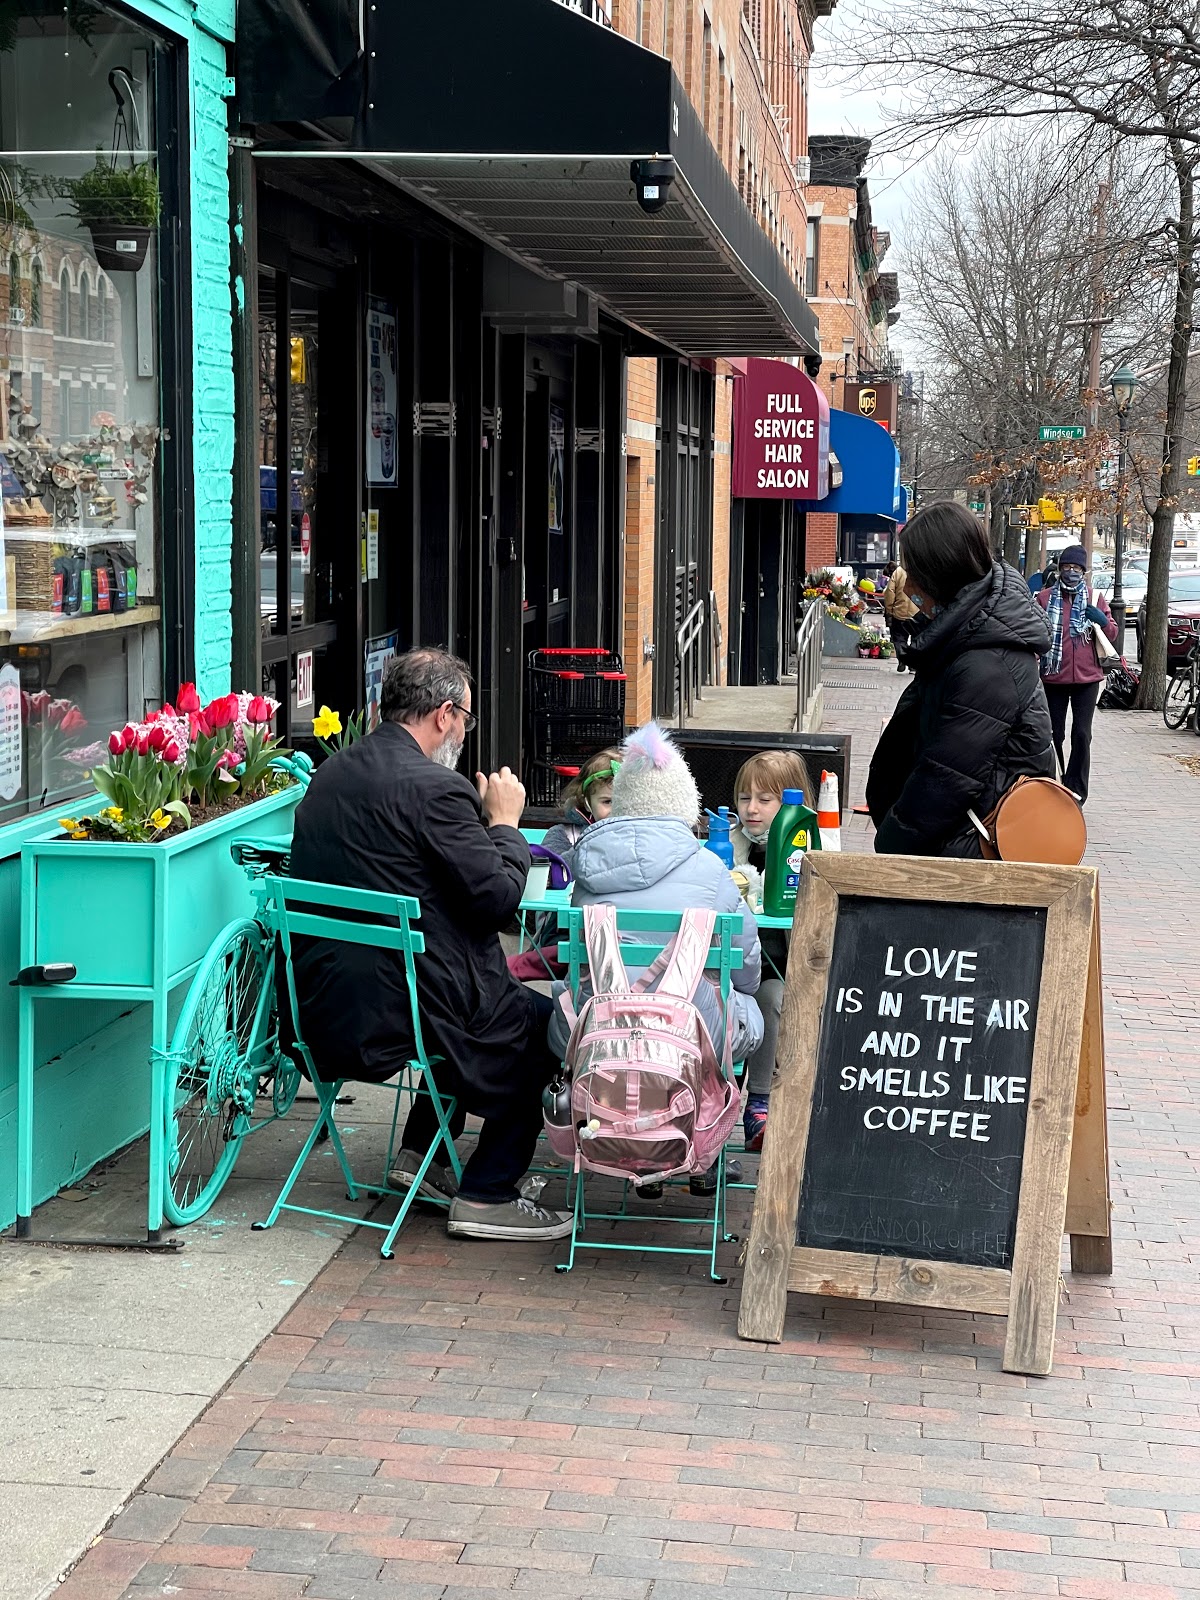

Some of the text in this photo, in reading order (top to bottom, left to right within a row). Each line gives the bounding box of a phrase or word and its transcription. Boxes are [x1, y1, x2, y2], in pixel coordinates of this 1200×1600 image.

[767, 394, 802, 413] FULL
[860, 396, 875, 413] ups
[754, 419, 814, 438] SERVICE
[1043, 428, 1074, 438] Windsor
[765, 444, 802, 463] HAIR
[757, 469, 809, 488] SALON
[299, 656, 311, 701] EXIT
[884, 946, 978, 982] LOVE
[835, 987, 1030, 1031] IS IN THE AIR
[860, 1031, 972, 1062] AND IT
[839, 1066, 1027, 1104] SMELLS LIKE
[863, 1106, 992, 1142] COFFEE
